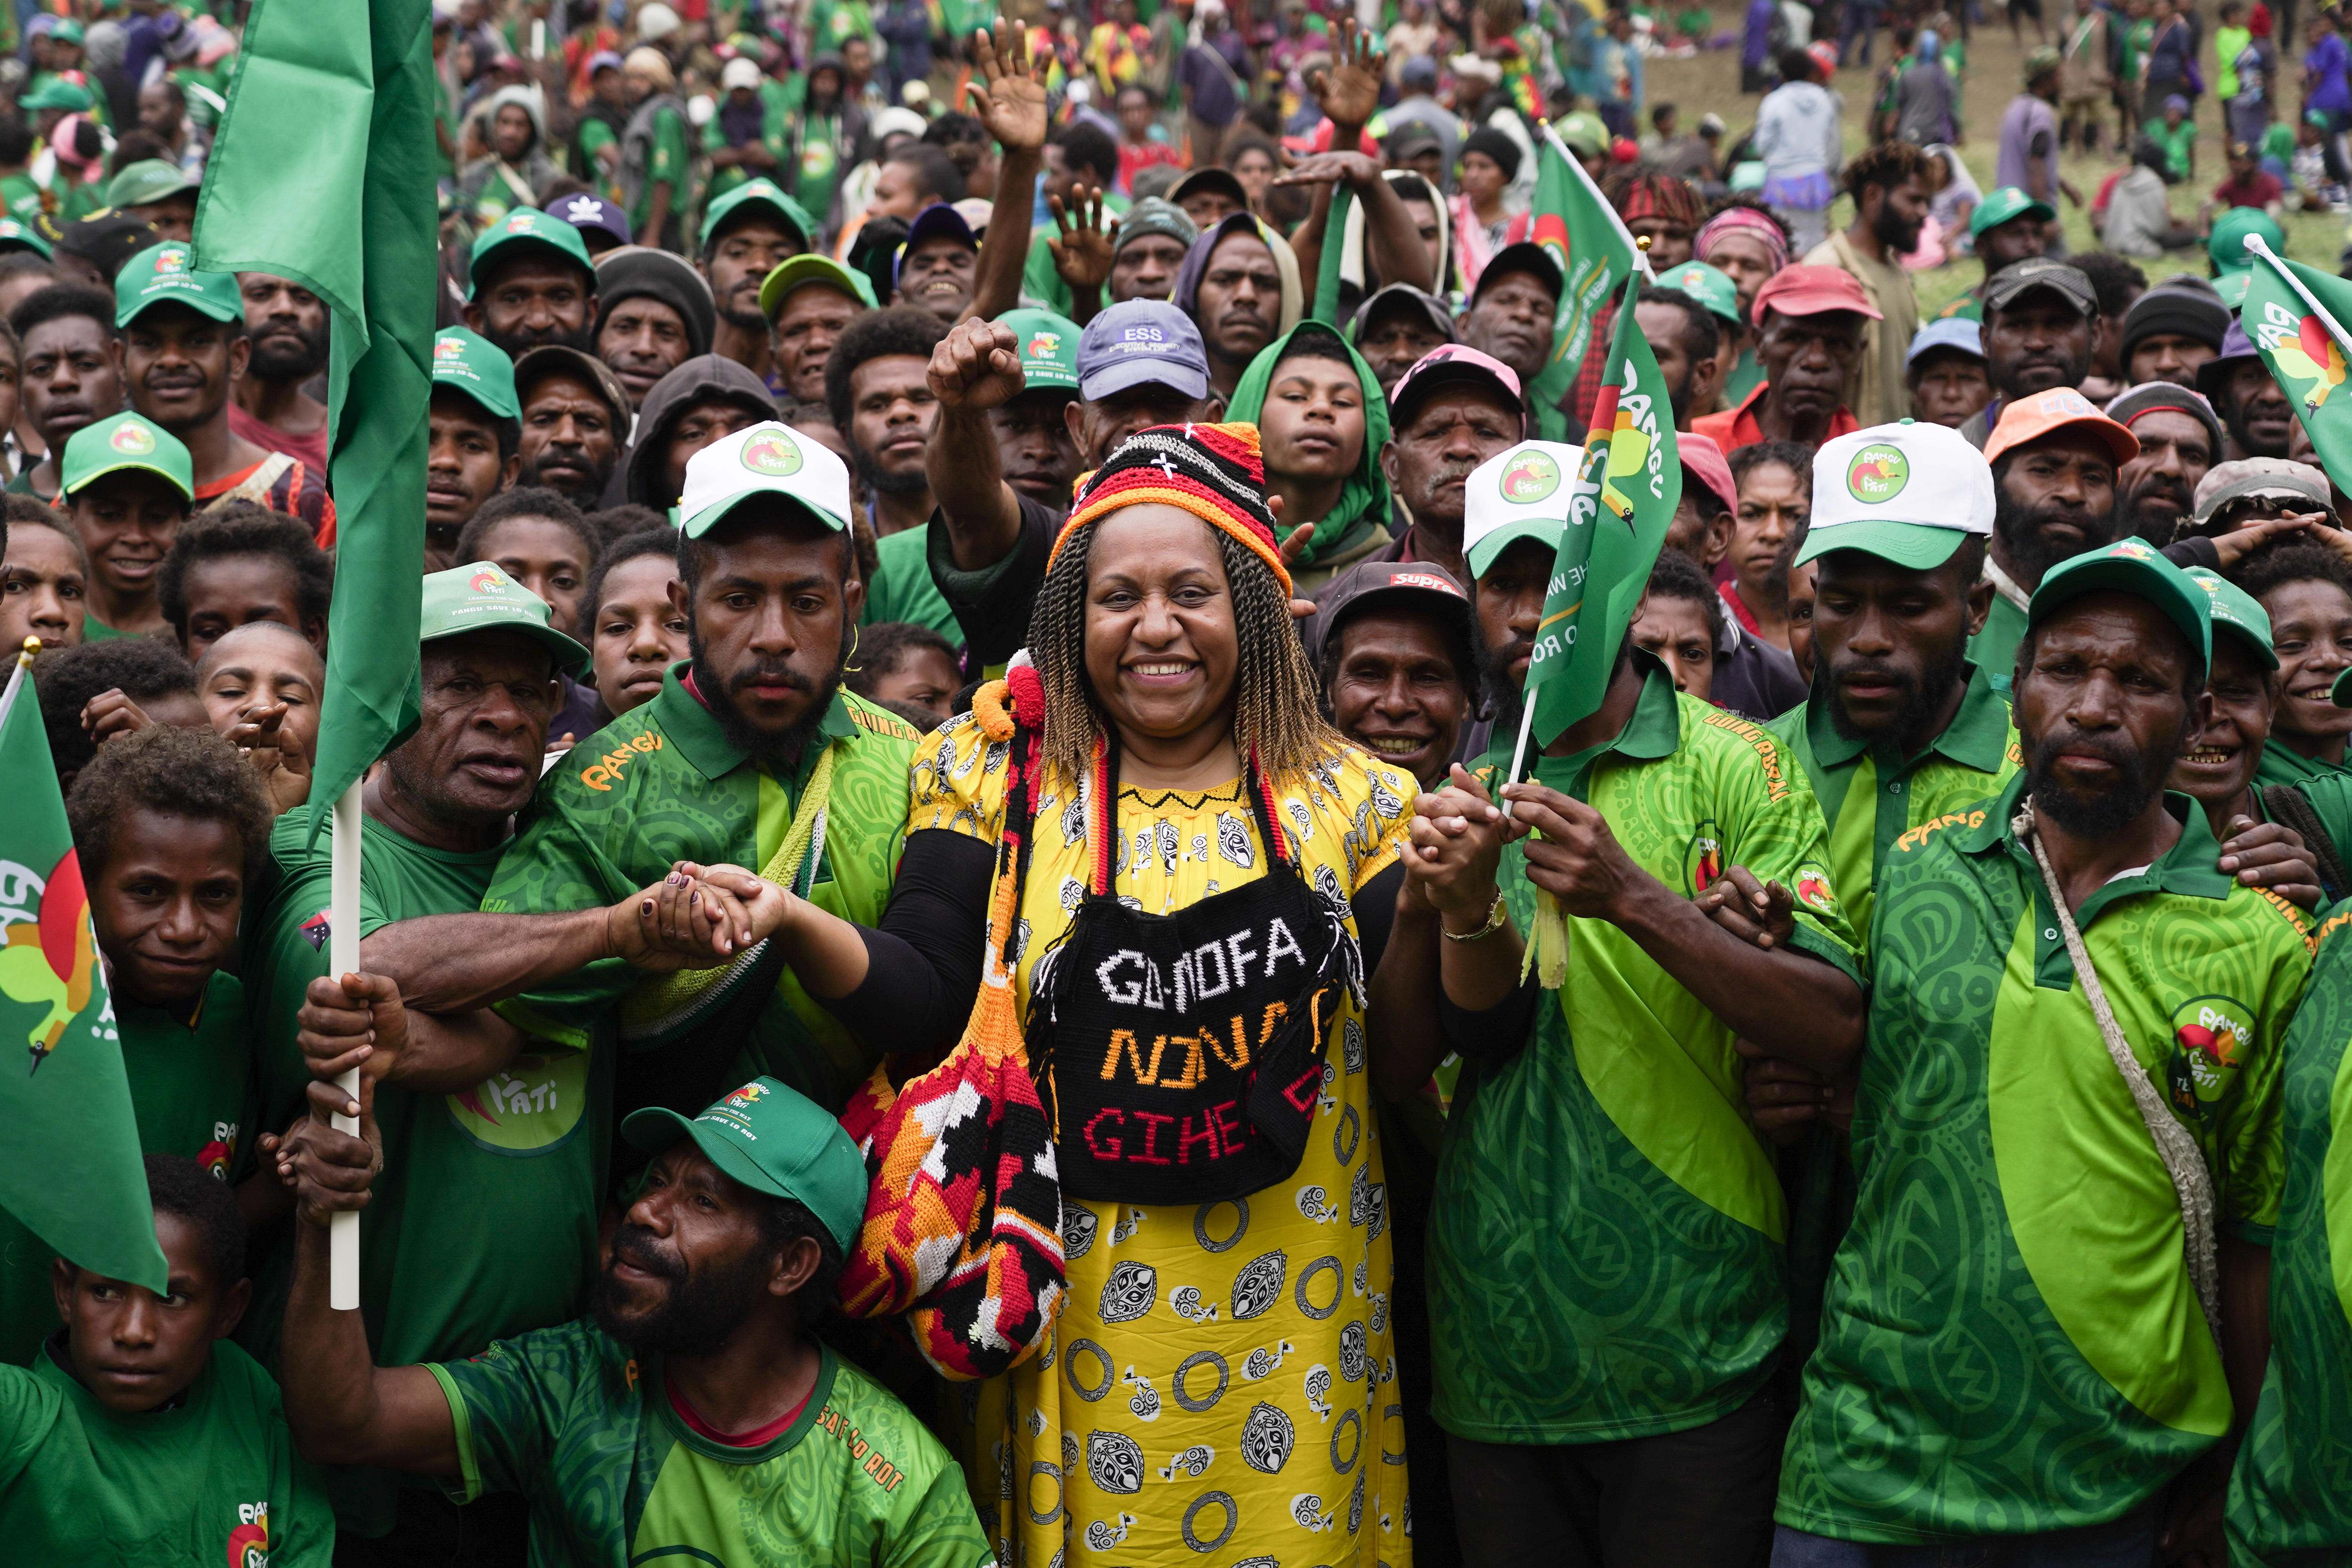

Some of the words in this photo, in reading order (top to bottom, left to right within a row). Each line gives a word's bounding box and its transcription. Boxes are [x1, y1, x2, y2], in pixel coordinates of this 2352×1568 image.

[1124, 328, 1163, 342] ESS
[755, 435, 793, 447] PANGU
[1512, 457, 1550, 471] PANGU
[1864, 452, 1901, 464] PANGU
[2121, 542, 2155, 555] PANGU
[1394, 573, 1459, 596] Supre
[452, 606, 483, 616] PANGU
[847, 706, 904, 740] GOING
[1702, 713, 1765, 742] GOING
[580, 730, 662, 791] PANGU
[1898, 810, 1986, 852] PANG
[2199, 1006, 2252, 1046] PANGU
[743, 1082, 771, 1095] PANGU
[739, 1113, 752, 1122] WAY
[710, 1115, 729, 1124] SAVE
[740, 1128, 757, 1141] ROT
[847, 1427, 869, 1460] LO
[863, 1451, 905, 1493] ROT
